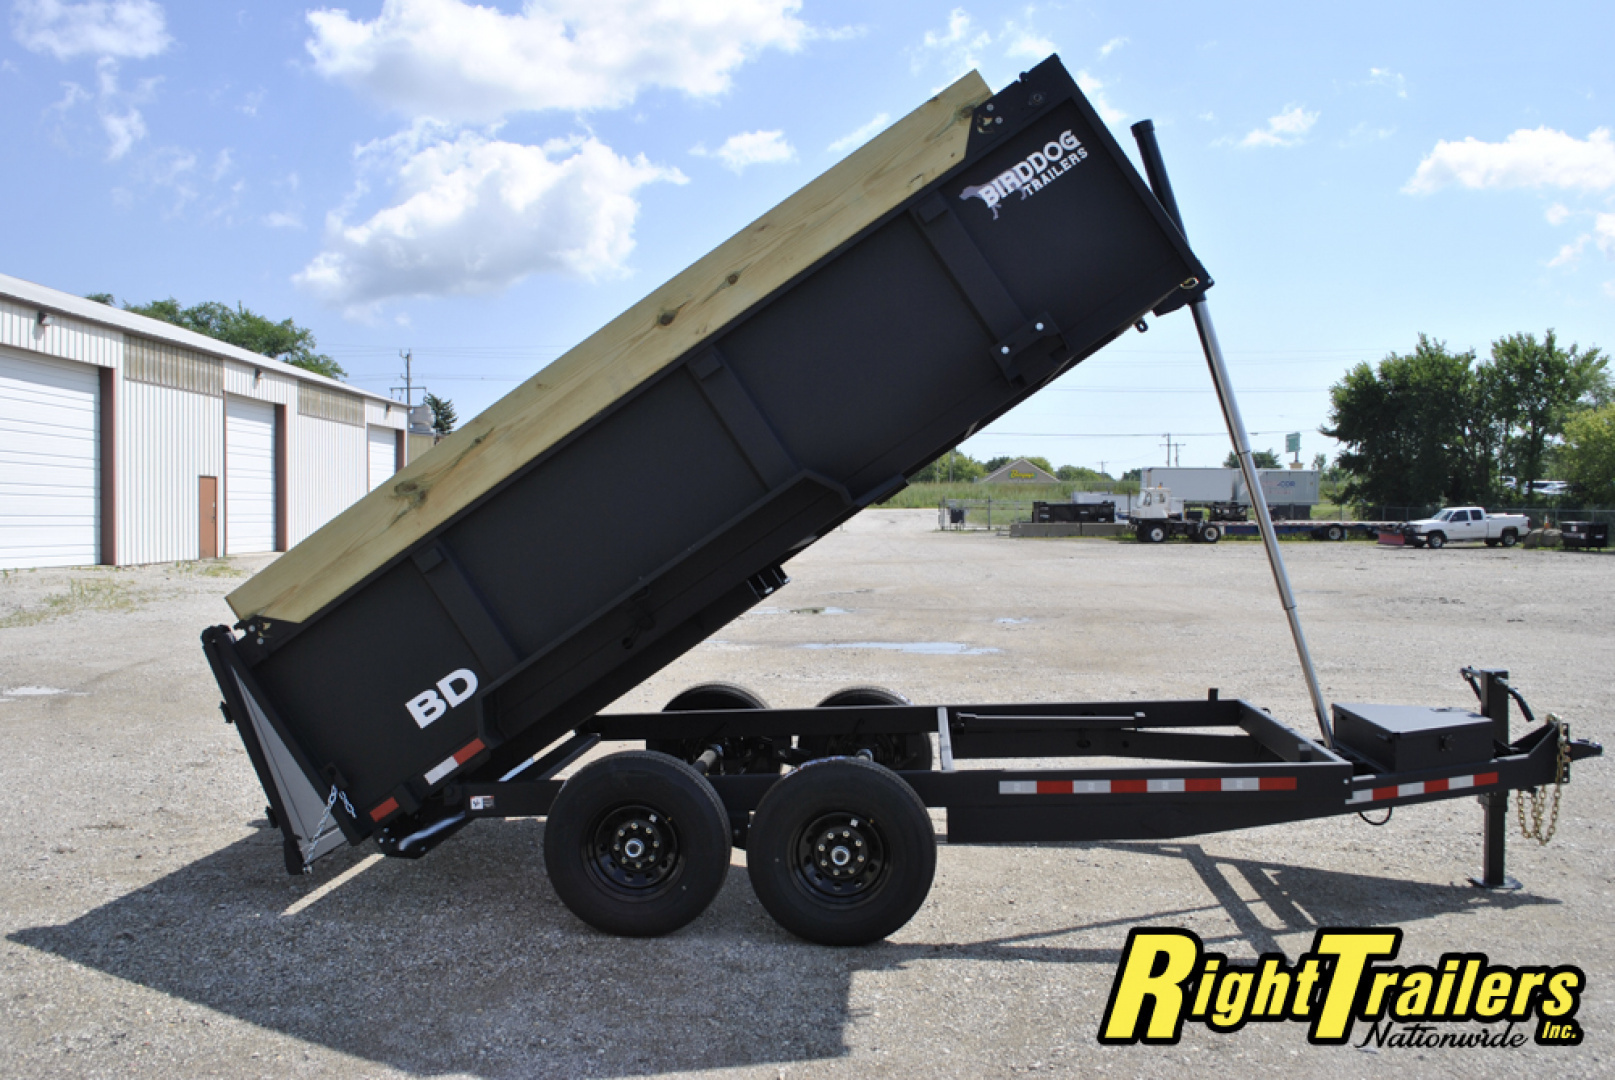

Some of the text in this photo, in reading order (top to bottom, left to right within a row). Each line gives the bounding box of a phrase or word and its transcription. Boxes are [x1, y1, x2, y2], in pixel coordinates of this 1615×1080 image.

[978, 129, 1082, 208] BIRDDOG
[1023, 147, 1088, 196] TRAILERS
[405, 668, 478, 730] BD
